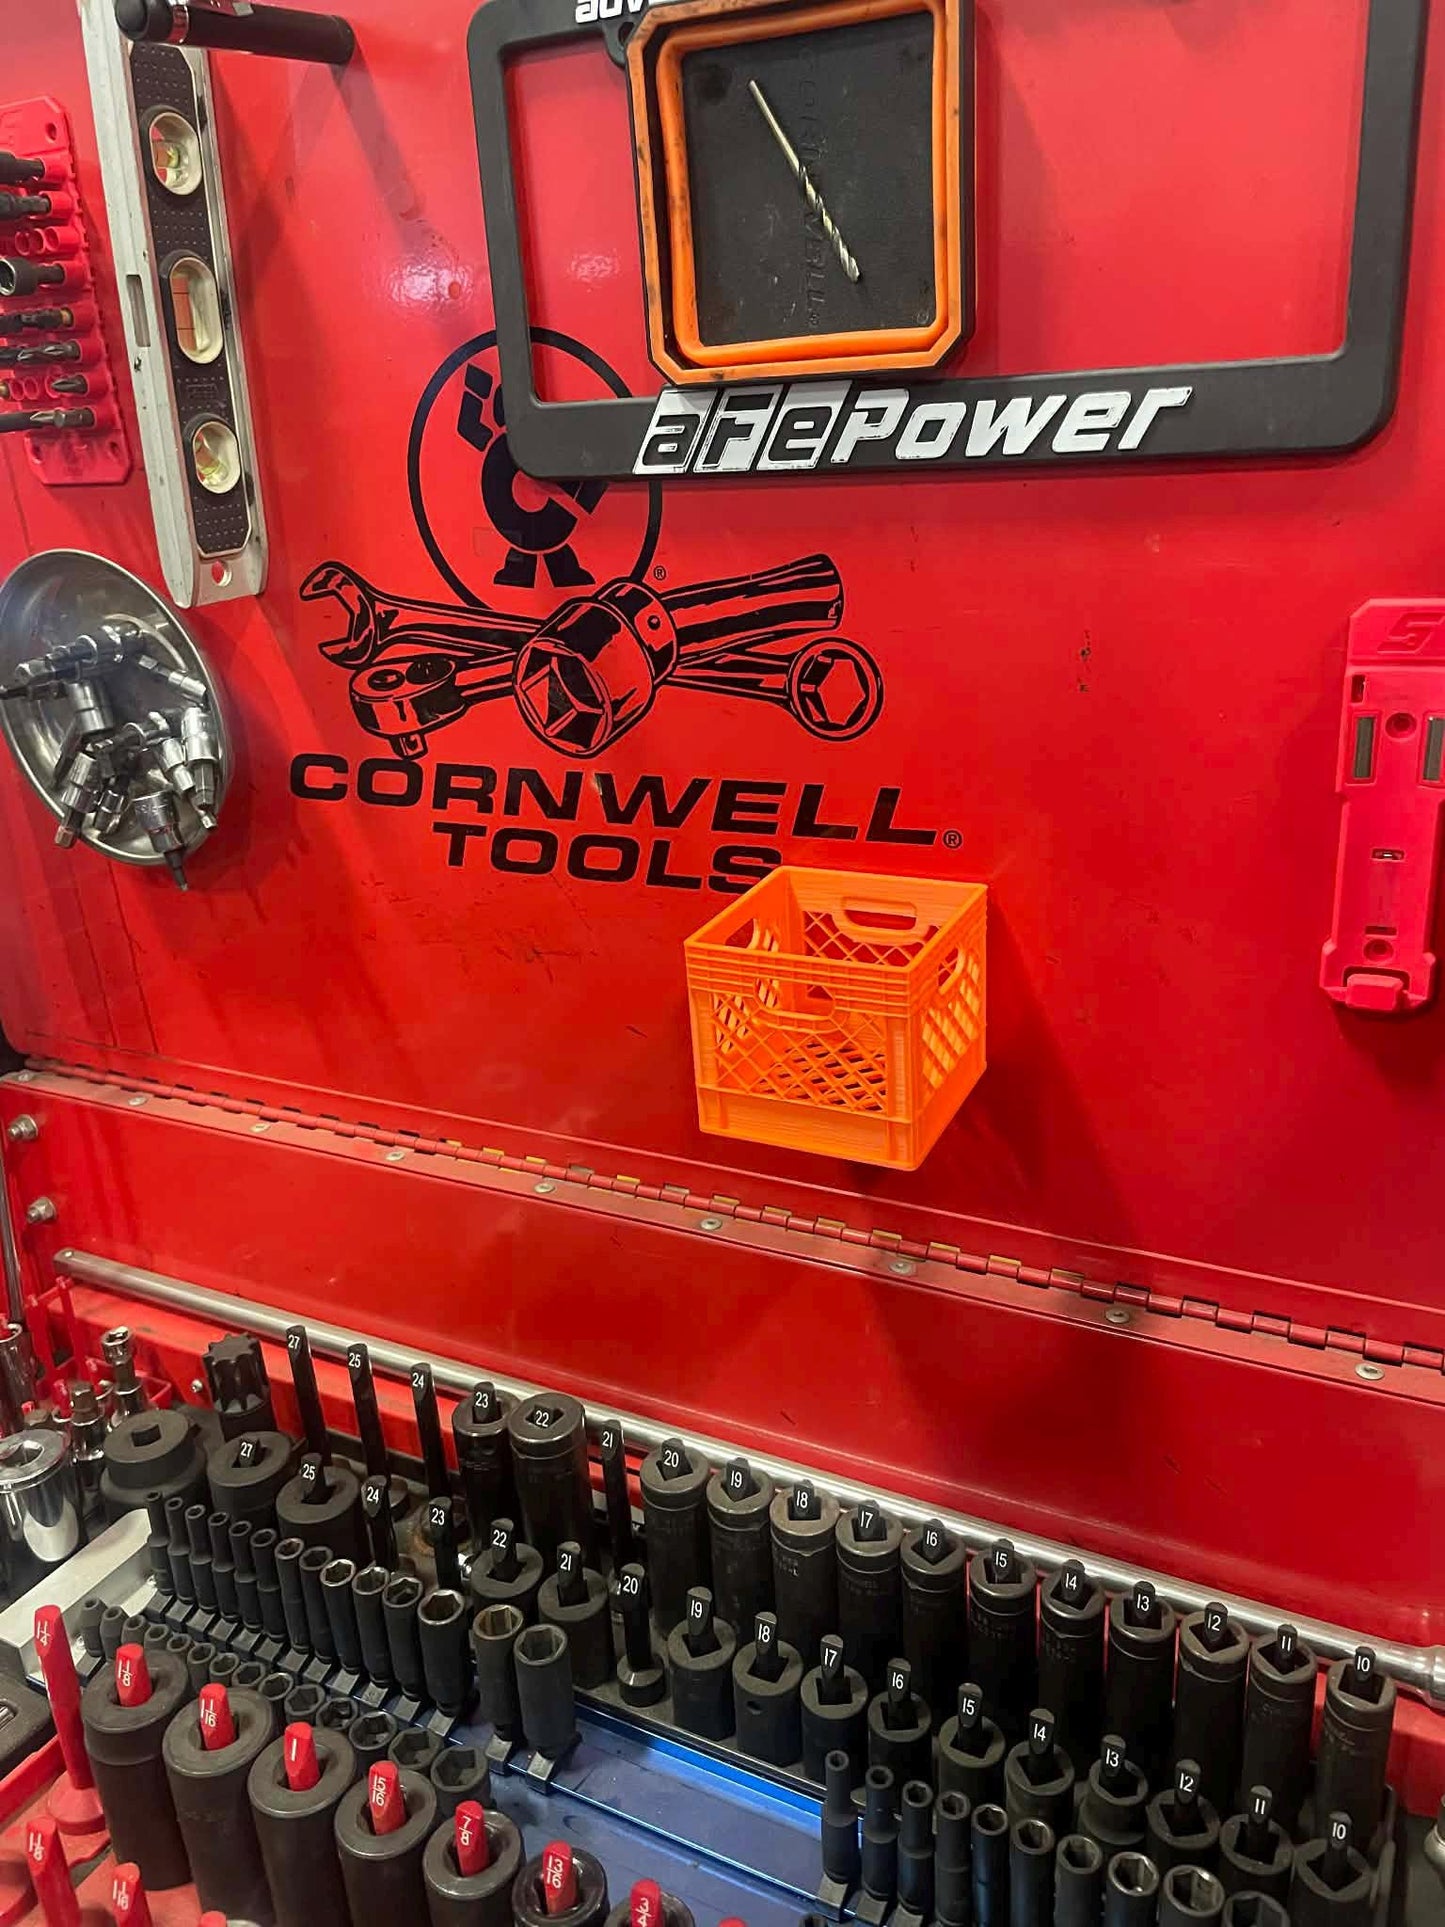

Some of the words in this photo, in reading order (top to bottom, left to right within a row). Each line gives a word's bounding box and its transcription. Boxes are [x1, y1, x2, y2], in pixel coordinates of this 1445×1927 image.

[432, 820, 782, 895] TOOLS
[287, 1334, 301, 1350] 27
[348, 1352, 361, 1369] 25
[412, 1372, 425, 1389] 24
[475, 1391, 489, 1409] 23
[535, 1410, 549, 1428] 22
[602, 1430, 613, 1448] 21
[240, 1441, 253, 1458] 27
[663, 1449, 679, 1468] 20
[302, 1463, 316, 1481] 25
[730, 1470, 743, 1489] 19
[366, 1486, 379, 1504] 24
[796, 1490, 809, 1509] 18
[431, 1507, 445, 1526] 23
[860, 1510, 874, 1529] 17
[492, 1529, 507, 1549] 22
[926, 1530, 938, 1547] 16
[560, 1553, 572, 1571] 21
[995, 1551, 1008, 1568] 15
[622, 1575, 639, 1595] 20
[1065, 1572, 1077, 1590] 14
[690, 1599, 703, 1619] 19
[1136, 1593, 1150, 1612] 13
[1207, 1613, 1221, 1632] 12
[758, 1623, 771, 1643] 18
[1281, 1635, 1292, 1652] 11
[824, 1647, 838, 1667] 17
[1357, 1655, 1371, 1672] 10
[892, 1671, 904, 1690] 16
[962, 1697, 975, 1716] 15
[1033, 1723, 1046, 1742] 14
[290, 1737, 298, 1763] 1
[1105, 1748, 1119, 1767] 13
[1179, 1772, 1194, 1793] 12
[1254, 1798, 1266, 1815] 11
[1332, 1822, 1347, 1840] 10
